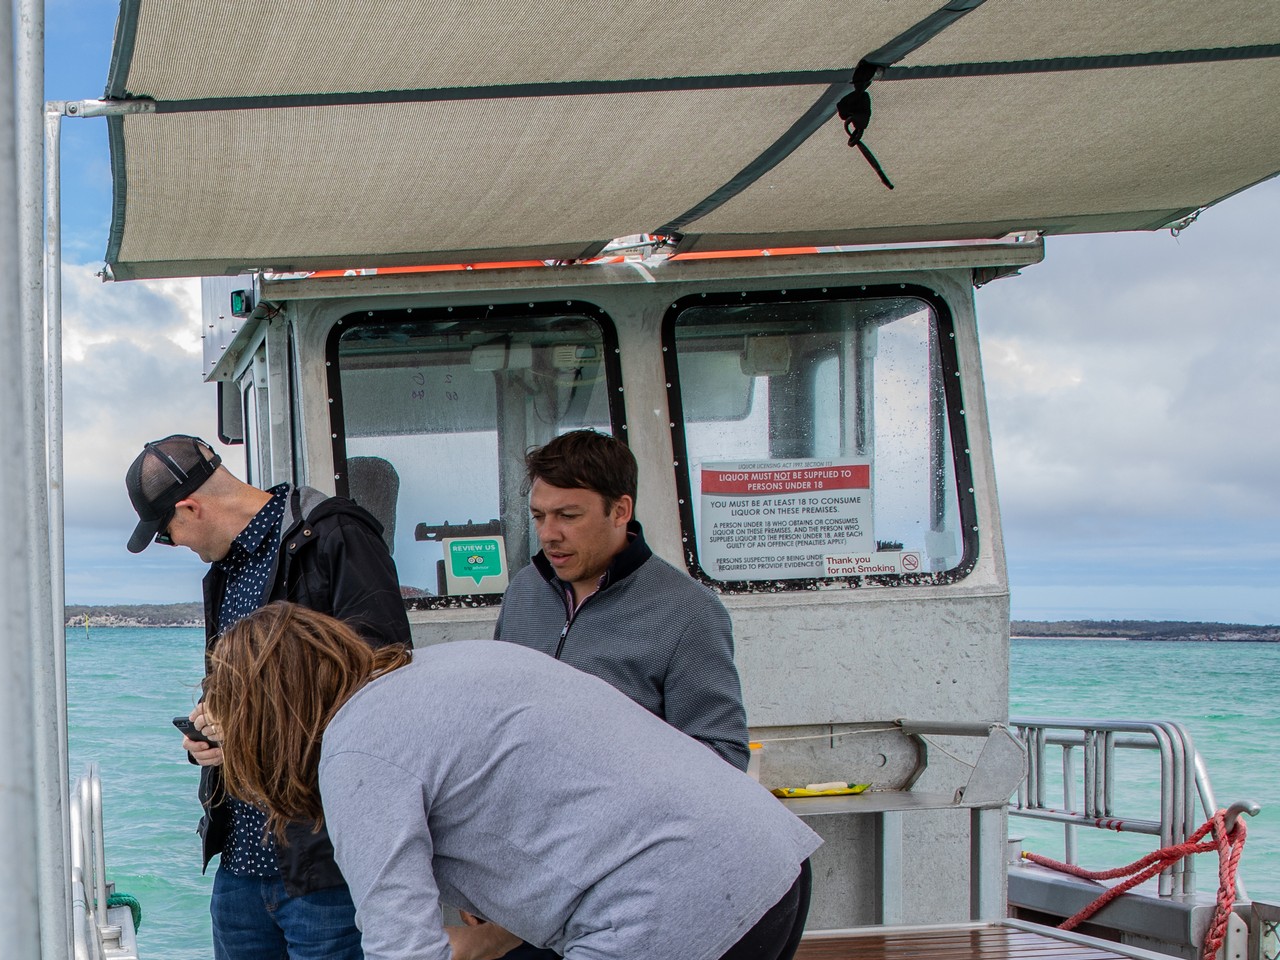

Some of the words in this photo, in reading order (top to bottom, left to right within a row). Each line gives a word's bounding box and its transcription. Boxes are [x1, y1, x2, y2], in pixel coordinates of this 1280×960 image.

[719, 474, 749, 482] LIQUOR
[774, 472, 790, 480] NOT
[793, 471, 802, 479] BE
[804, 470, 838, 479] SUPPLIED
[802, 506, 839, 514] PREMISES.
[858, 565, 895, 574] Smoking
